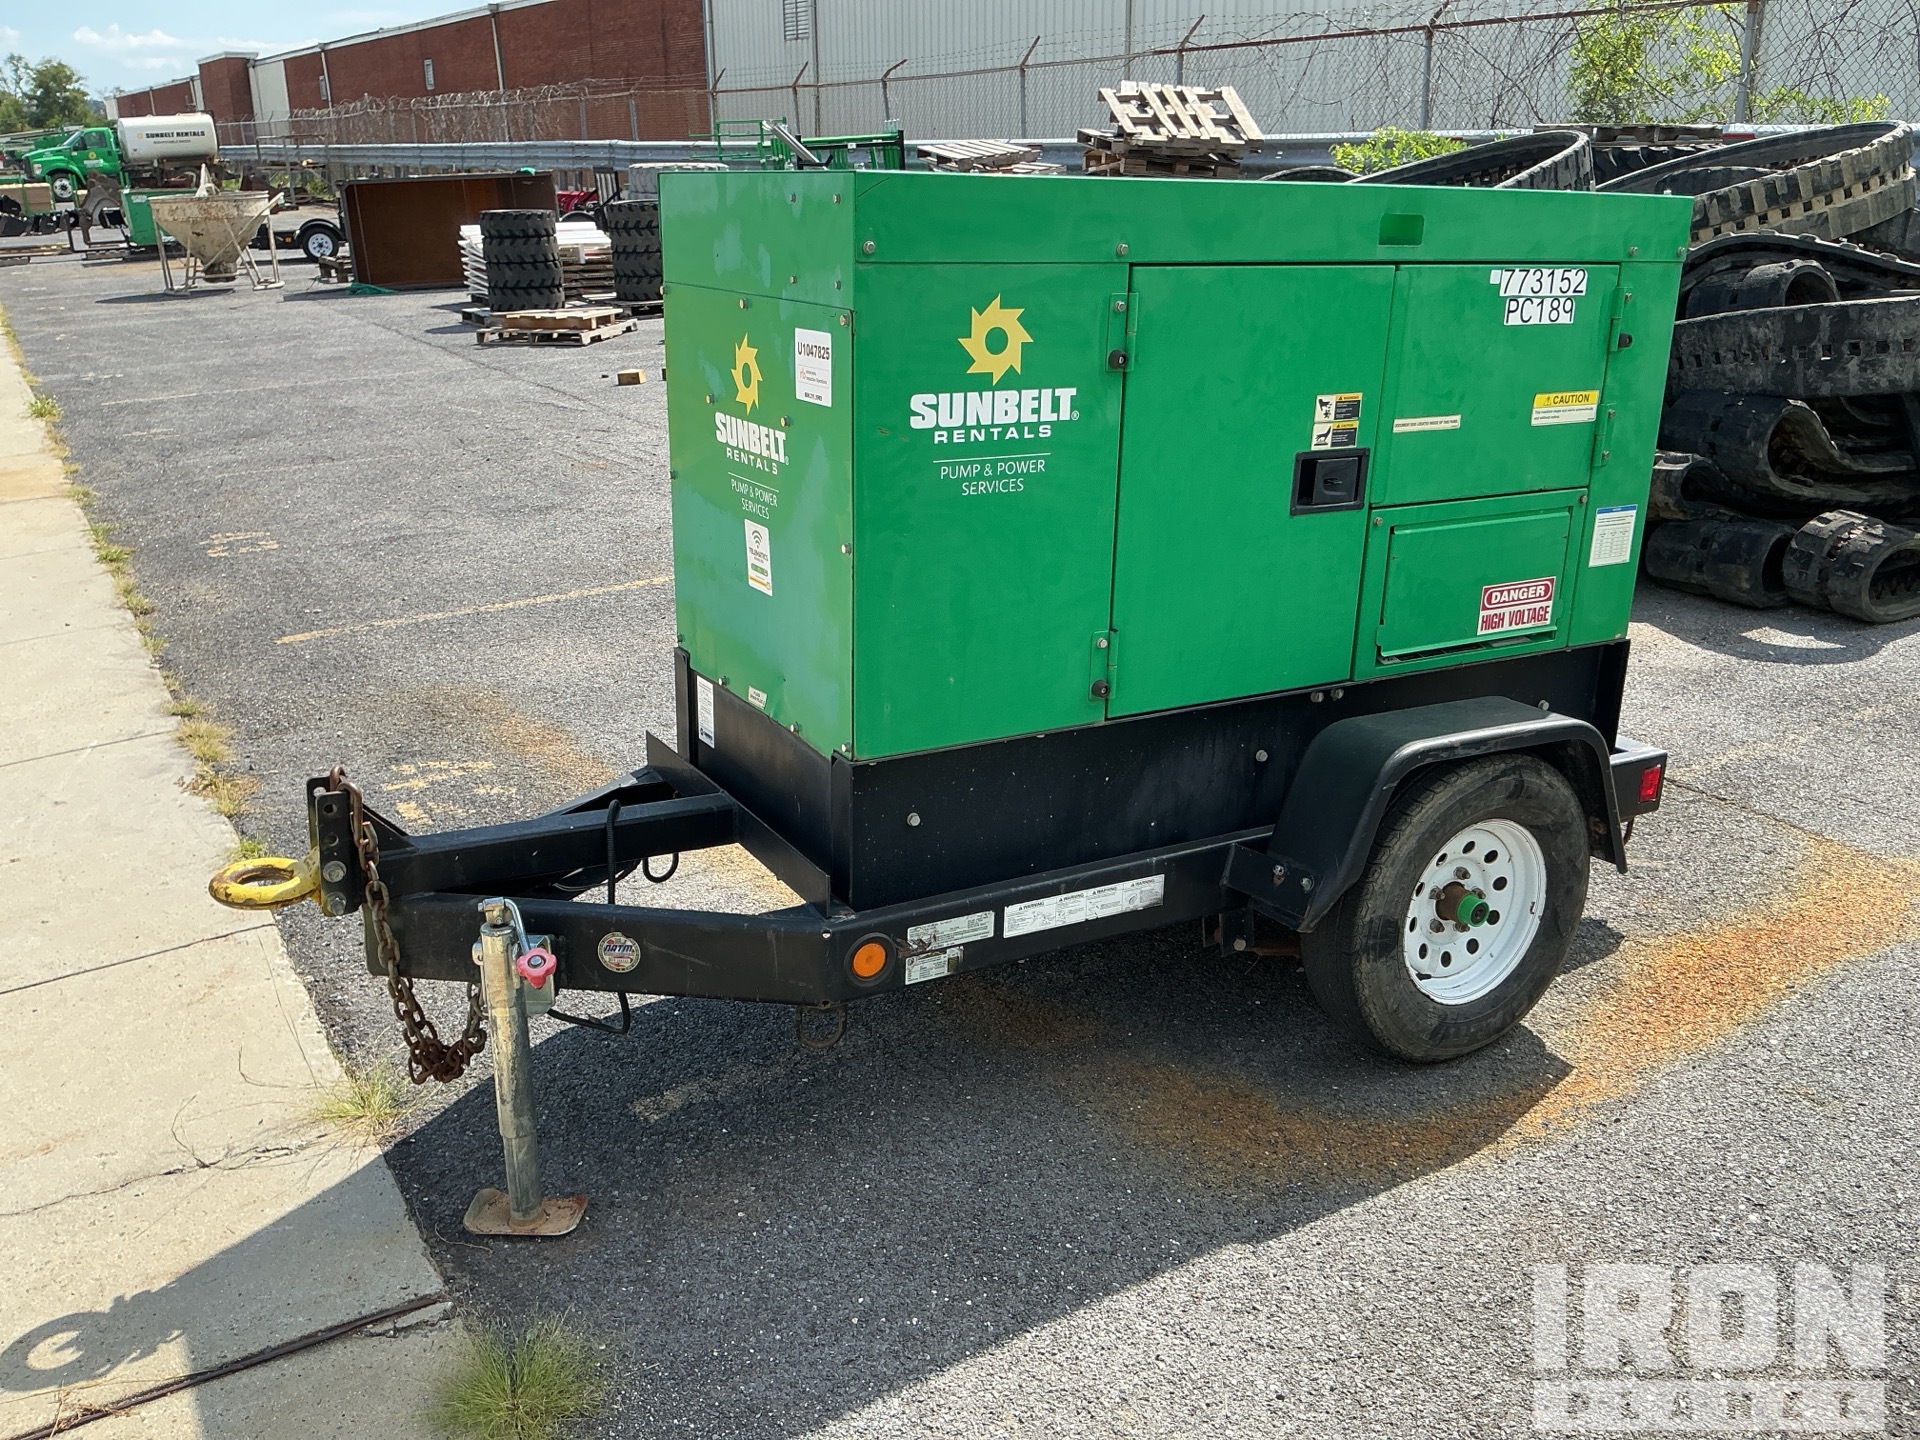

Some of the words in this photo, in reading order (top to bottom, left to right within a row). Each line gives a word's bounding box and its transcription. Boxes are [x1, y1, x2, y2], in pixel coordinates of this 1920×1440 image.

[145, 131, 175, 139] SUNBELT
[176, 130, 206, 138] RENTALS
[1503, 268, 1586, 295] 773152
[1505, 297, 1574, 324] PC189
[797, 341, 830, 361] U1047825
[1552, 393, 1590, 405] CAUTION
[933, 424, 1052, 445] RENTALS
[726, 447, 778, 475] RENTALS
[940, 464, 981, 480] PUMP
[983, 463, 993, 476] &
[997, 459, 1046, 476] POWER
[731, 479, 749, 495] PUMP
[749, 486, 754, 498] &
[755, 487, 778, 508] POWER
[961, 478, 1025, 496] SERVICES
[741, 497, 770, 520] SERVICES
[1490, 585, 1546, 605] DANGER
[1480, 612, 1506, 632] HIGH
[1508, 605, 1551, 628] VOLTAGE
[1062, 893, 1085, 902] WARNING
[1096, 886, 1118, 894] WARNING
[1023, 901, 1045, 910] WARNING
